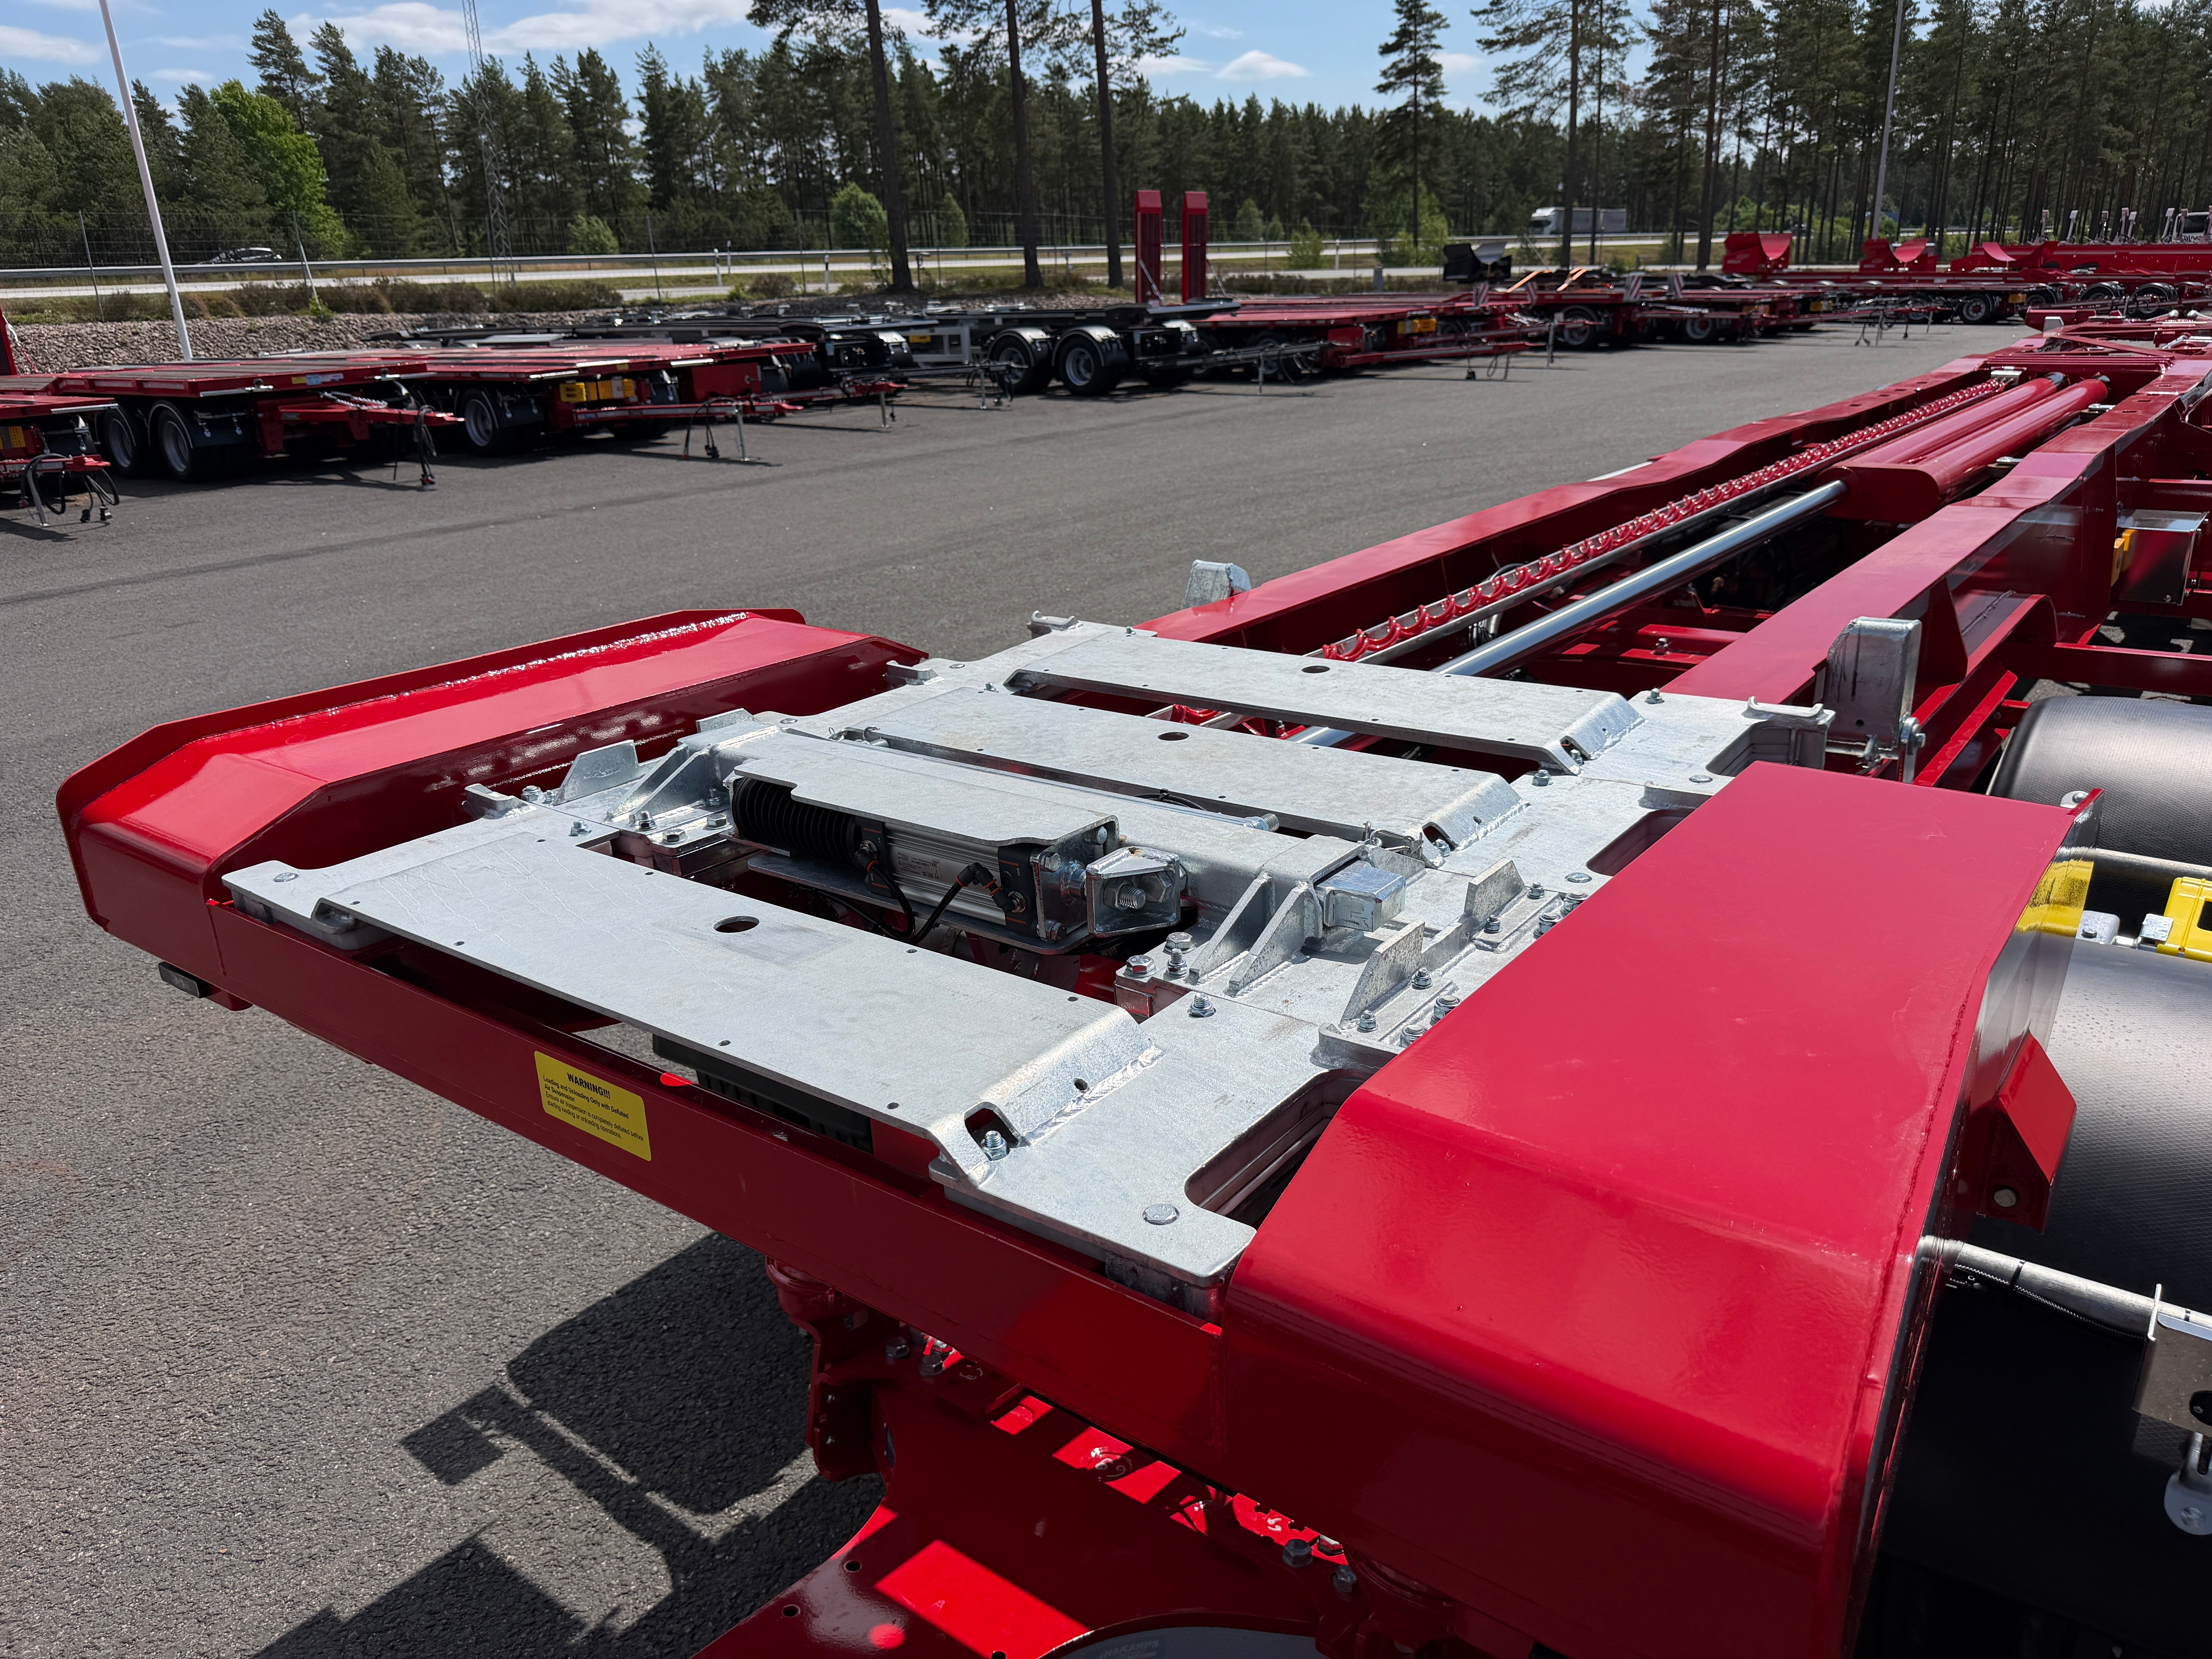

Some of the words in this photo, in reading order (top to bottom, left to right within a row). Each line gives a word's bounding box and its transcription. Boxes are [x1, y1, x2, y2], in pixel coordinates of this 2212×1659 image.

[543, 1075, 559, 1089] Loading
[568, 1087, 589, 1102] Unloading
[590, 1097, 599, 1107] Only
[611, 1106, 629, 1118] Deflated
[551, 1086, 575, 1102] Suspension
[567, 1073, 610, 1099] WARNING!!!
[591, 1114, 612, 1128] completely
[613, 1123, 630, 1135] deflated
[630, 1130, 643, 1141] before
